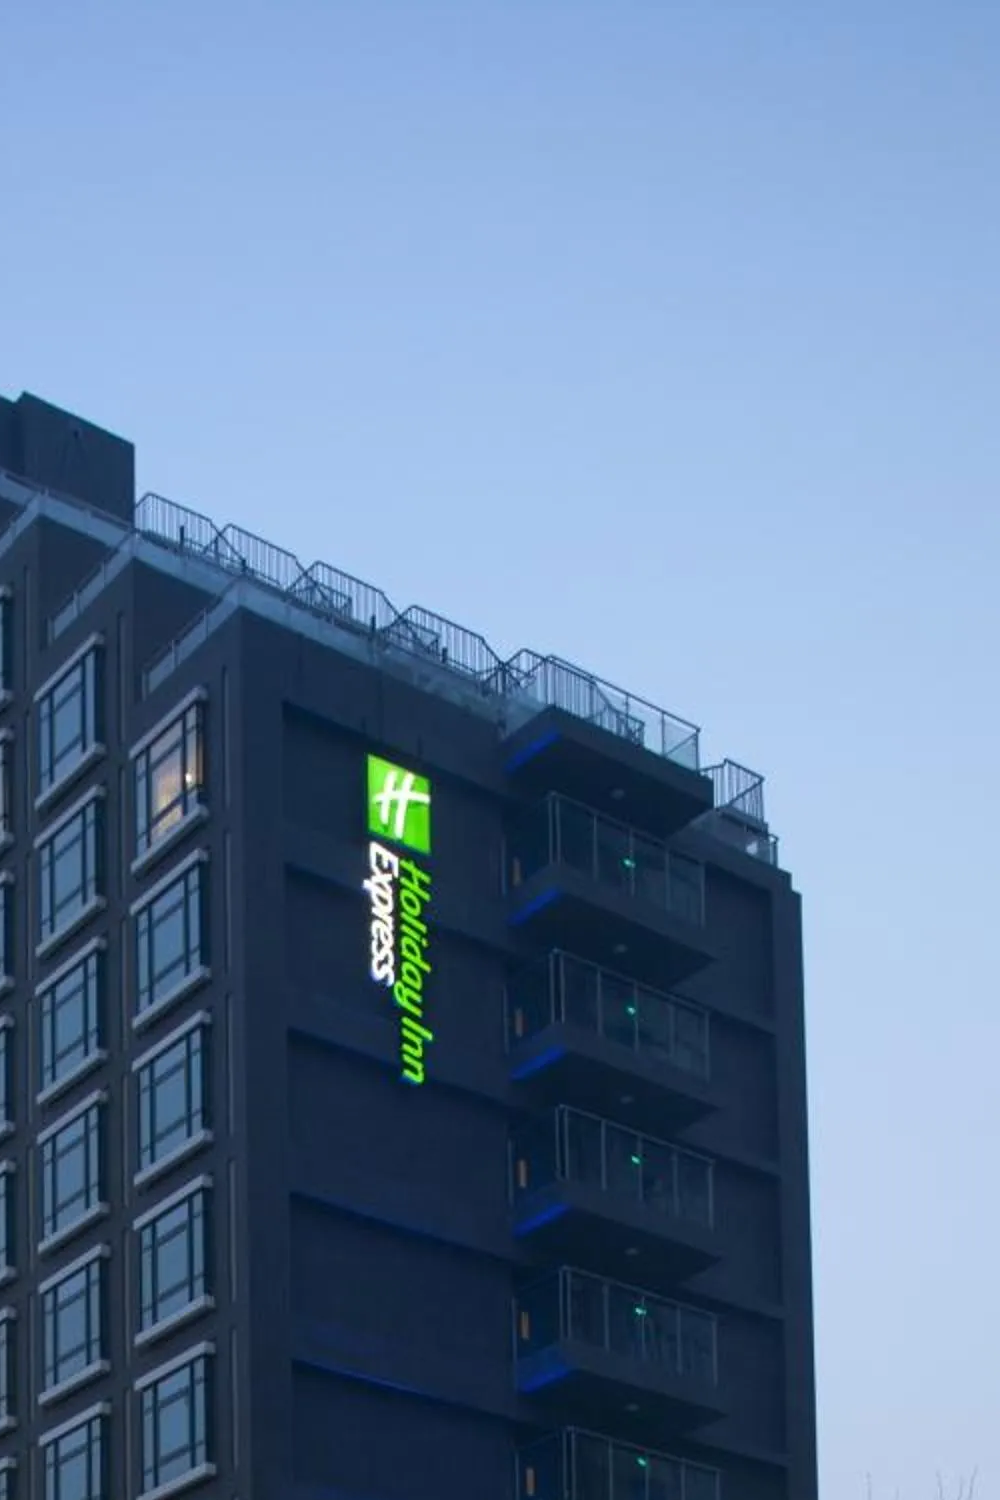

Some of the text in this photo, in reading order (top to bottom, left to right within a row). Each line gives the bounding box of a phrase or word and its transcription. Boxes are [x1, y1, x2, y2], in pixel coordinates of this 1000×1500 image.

[363, 841, 400, 987] Express
[395, 857, 433, 1085] Holiday Inn
